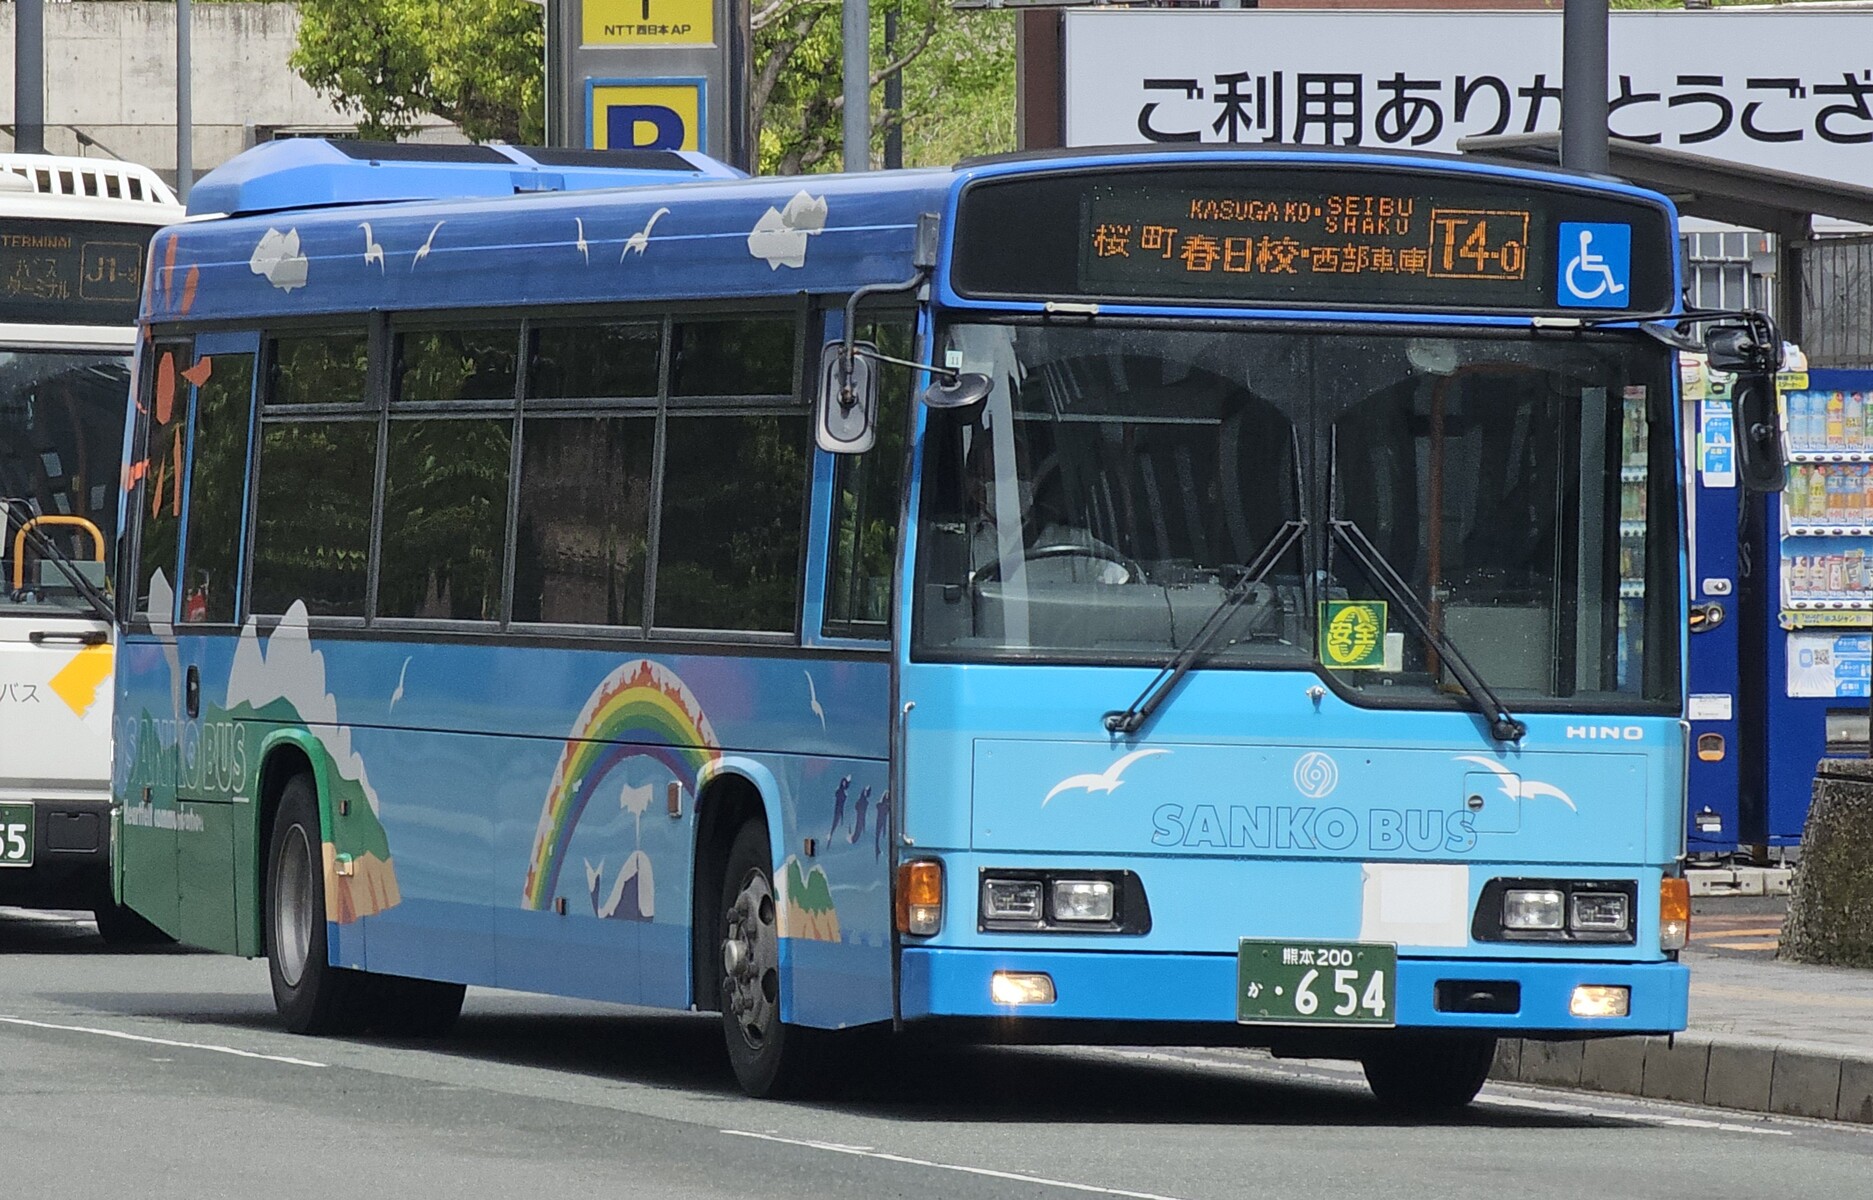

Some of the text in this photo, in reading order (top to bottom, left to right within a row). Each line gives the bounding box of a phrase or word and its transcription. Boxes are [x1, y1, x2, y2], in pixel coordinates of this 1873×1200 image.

[1326, 216, 1408, 235] SHAKU
[1436, 217, 1521, 272] T4-0
[1330, 622, 1377, 645] 安全
[1566, 726, 1644, 740] HINO
[203, 722, 246, 794] BUS
[1151, 803, 1478, 853] SANKO BUS
[1247, 981, 1263, 998] か
